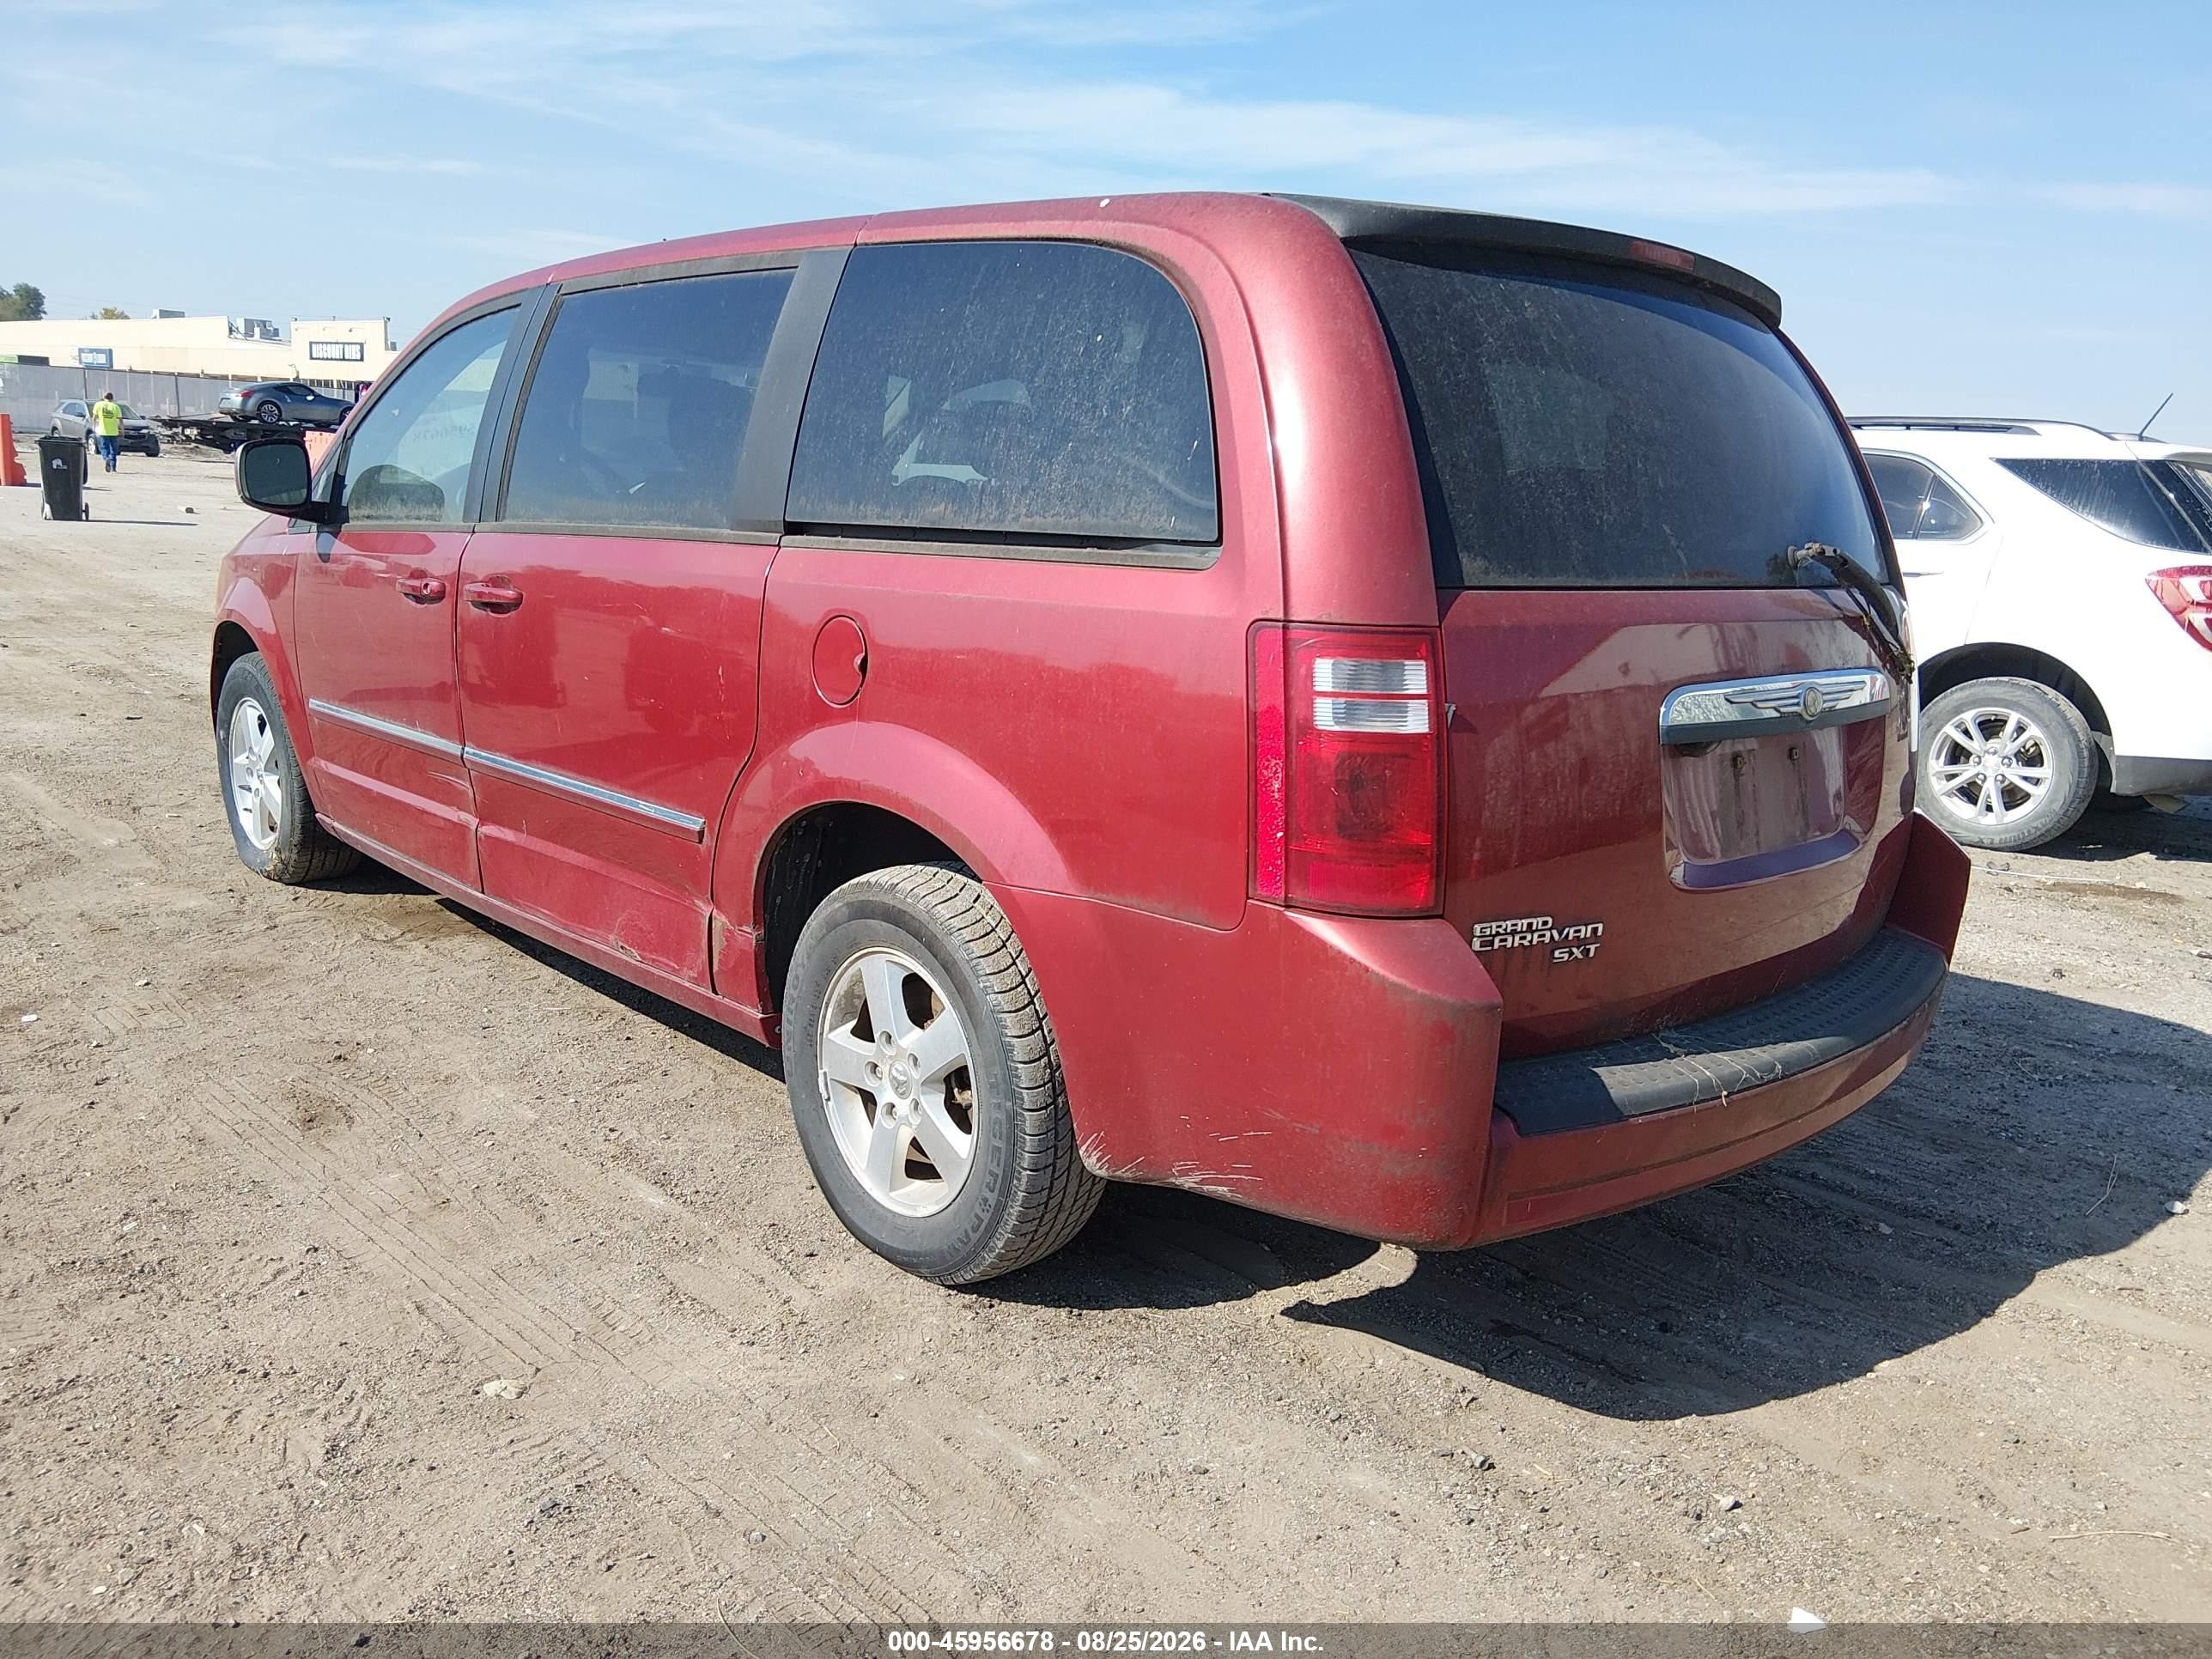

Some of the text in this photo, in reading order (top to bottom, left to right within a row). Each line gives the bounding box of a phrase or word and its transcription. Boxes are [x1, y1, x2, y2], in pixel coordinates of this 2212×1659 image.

[312, 343, 343, 359] DISCOUNT
[1473, 916, 1553, 936] GRAND
[1472, 922, 1604, 951] CARAVAN
[1553, 944, 1601, 963] SXT
